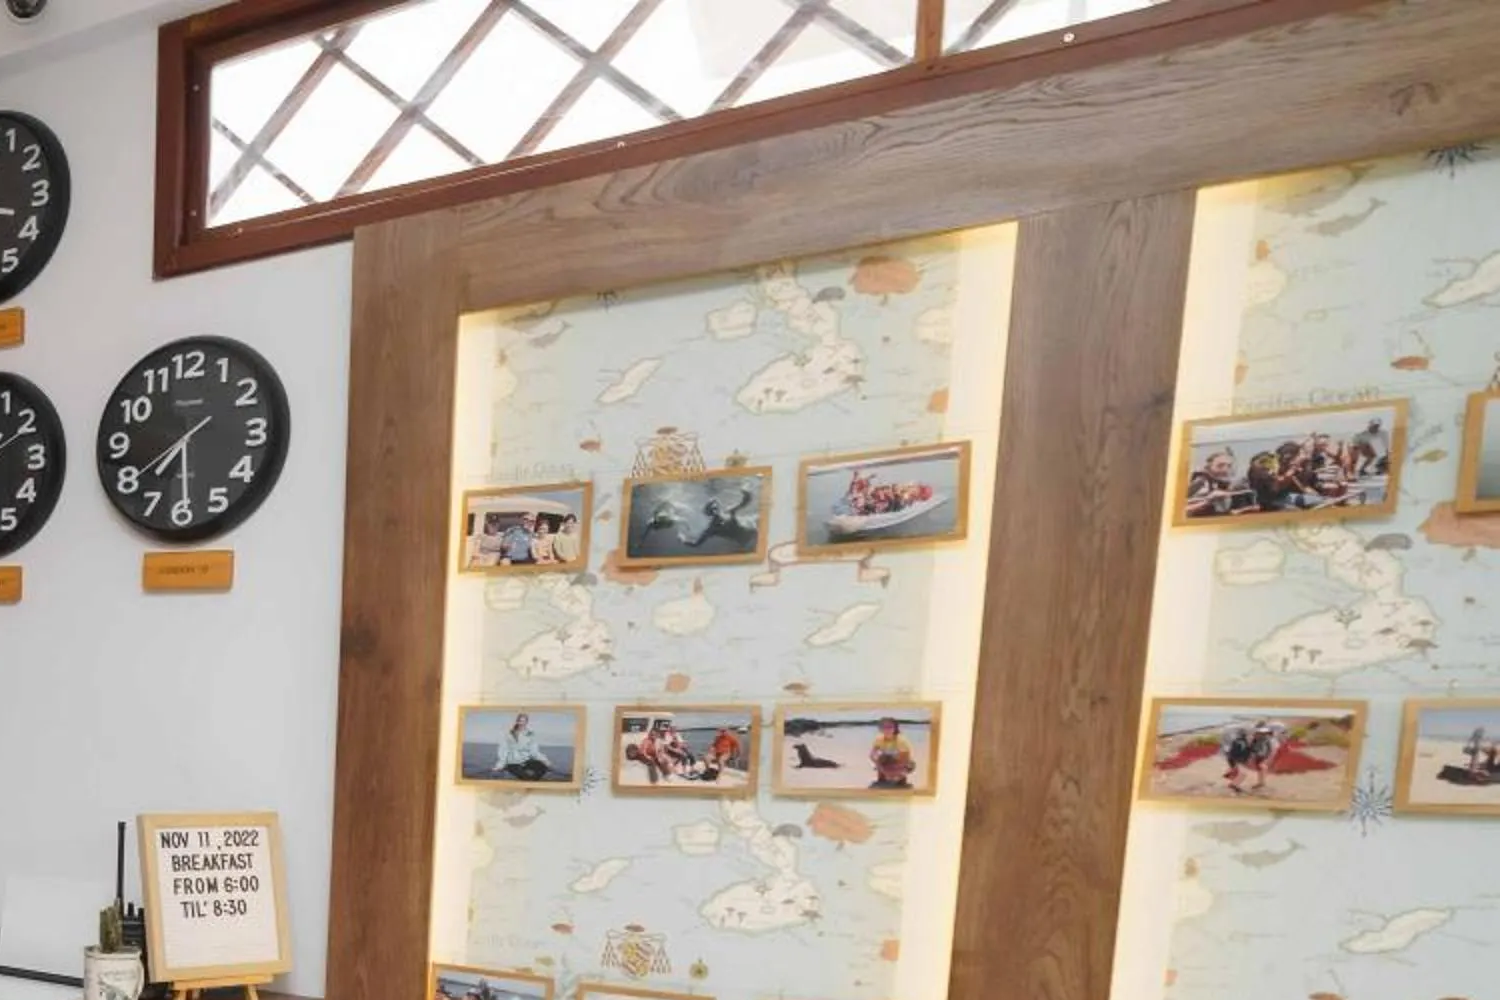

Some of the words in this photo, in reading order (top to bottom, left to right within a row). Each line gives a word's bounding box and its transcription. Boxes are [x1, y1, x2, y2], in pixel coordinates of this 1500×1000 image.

[5, 128, 17, 153] 1
[21, 144, 41, 171] 2
[31, 179, 49, 207] 3
[17, 215, 40, 241] 4
[1, 247, 19, 273] 5
[171, 351, 206, 380] 12
[216, 357, 229, 383] 1
[143, 367, 169, 393] 11
[235, 378, 258, 406] 2
[0, 390, 11, 414] 1
[120, 395, 152, 424] 10
[17, 409, 37, 434] 2
[244, 417, 267, 447] 3
[27, 443, 45, 470] 3
[108, 432, 131, 459] 9
[116, 465, 140, 494] 8
[228, 455, 255, 483] 4
[16, 477, 37, 503] 4
[208, 487, 229, 513] 5
[143, 491, 163, 517] 7
[171, 498, 193, 526] 6
[0, 507, 17, 531] 5
[160, 832, 189, 849] NOV
[171, 853, 254, 872] BREAKFAST
[173, 877, 219, 895] FROM
[223, 875, 259, 893] 6:00
[213, 899, 247, 917] 8:30
